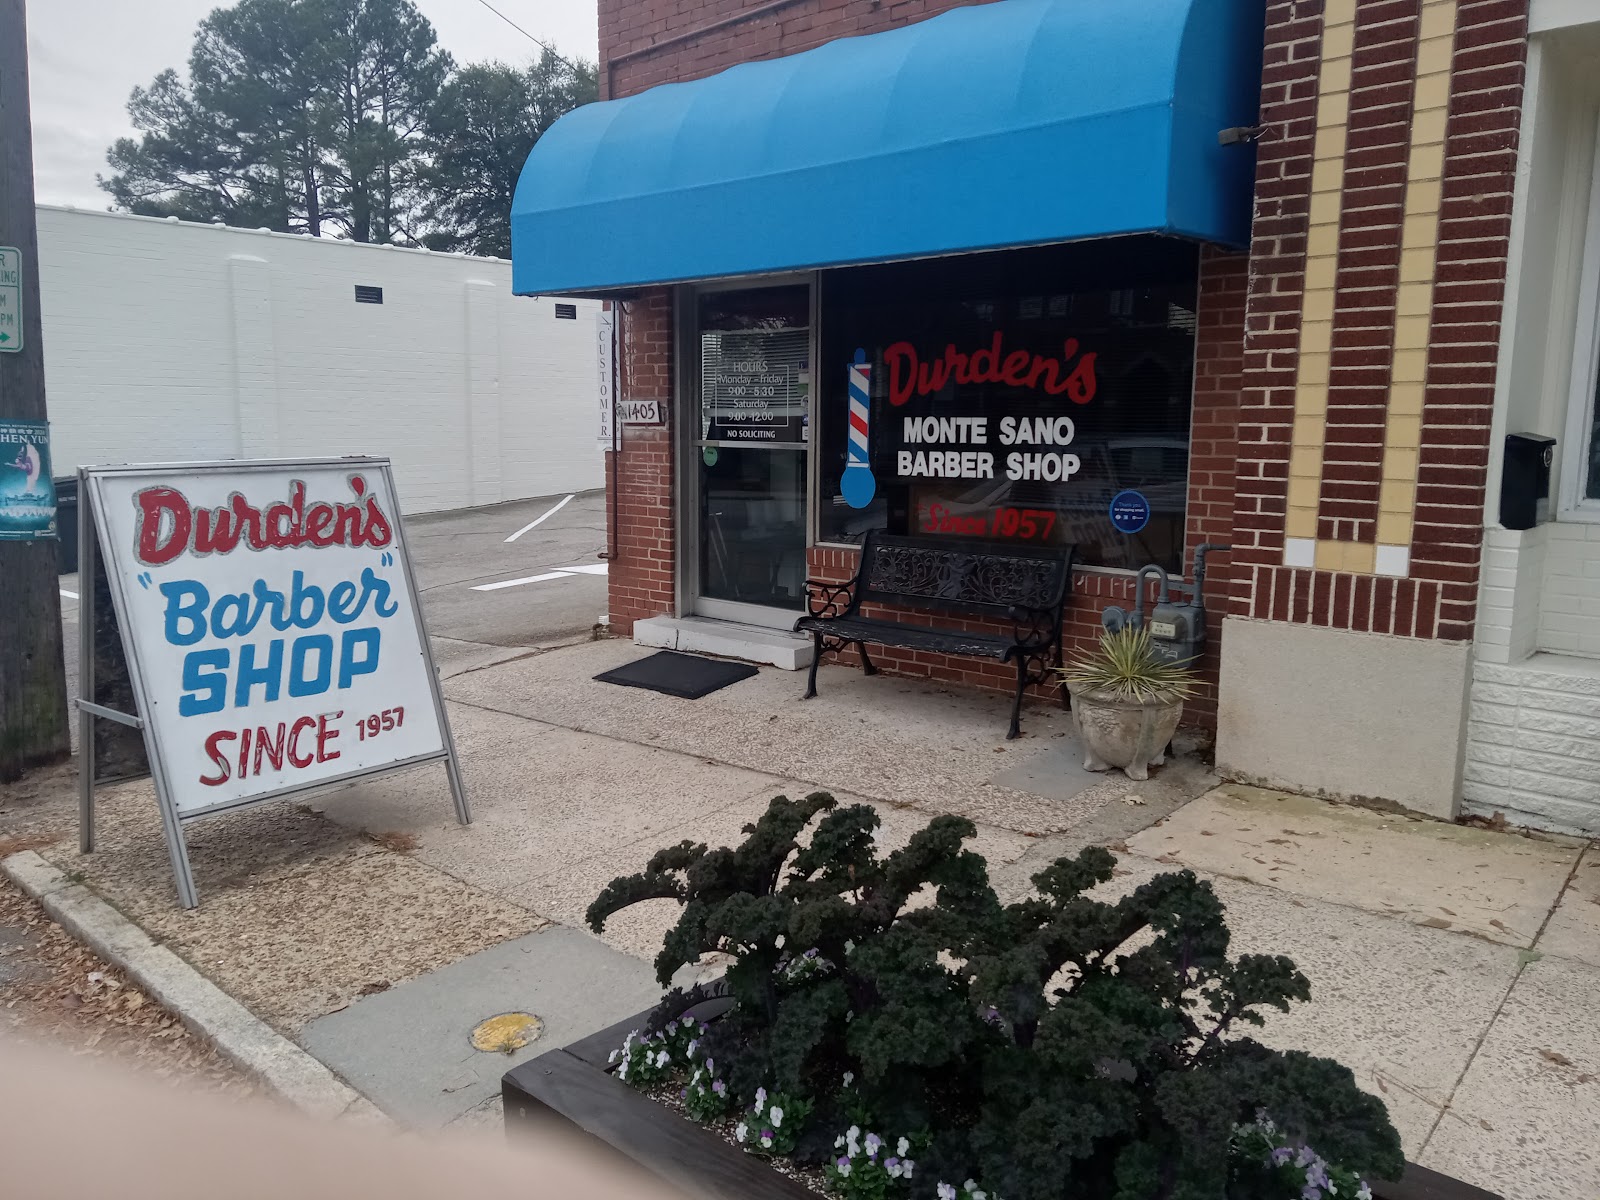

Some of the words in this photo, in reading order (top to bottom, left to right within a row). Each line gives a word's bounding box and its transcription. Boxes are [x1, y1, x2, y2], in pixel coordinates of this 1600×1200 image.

[719, 375, 751, 386] Monday
[733, 361, 768, 372] HOURS
[884, 330, 1097, 406] Durden's
[628, 402, 655, 420] 1405
[734, 399, 768, 410] Saturday
[738, 430, 776, 438] SOLICITING
[903, 416, 987, 444] MONTE
[999, 416, 1075, 446] SANO
[898, 451, 994, 479] BARBER
[1006, 452, 1081, 481] SHOP
[131, 473, 393, 567] Durden's
[991, 508, 1056, 541] 1957
[179, 627, 381, 717] SHOP
[199, 710, 344, 787] SINCE
[356, 706, 404, 742] 1957
